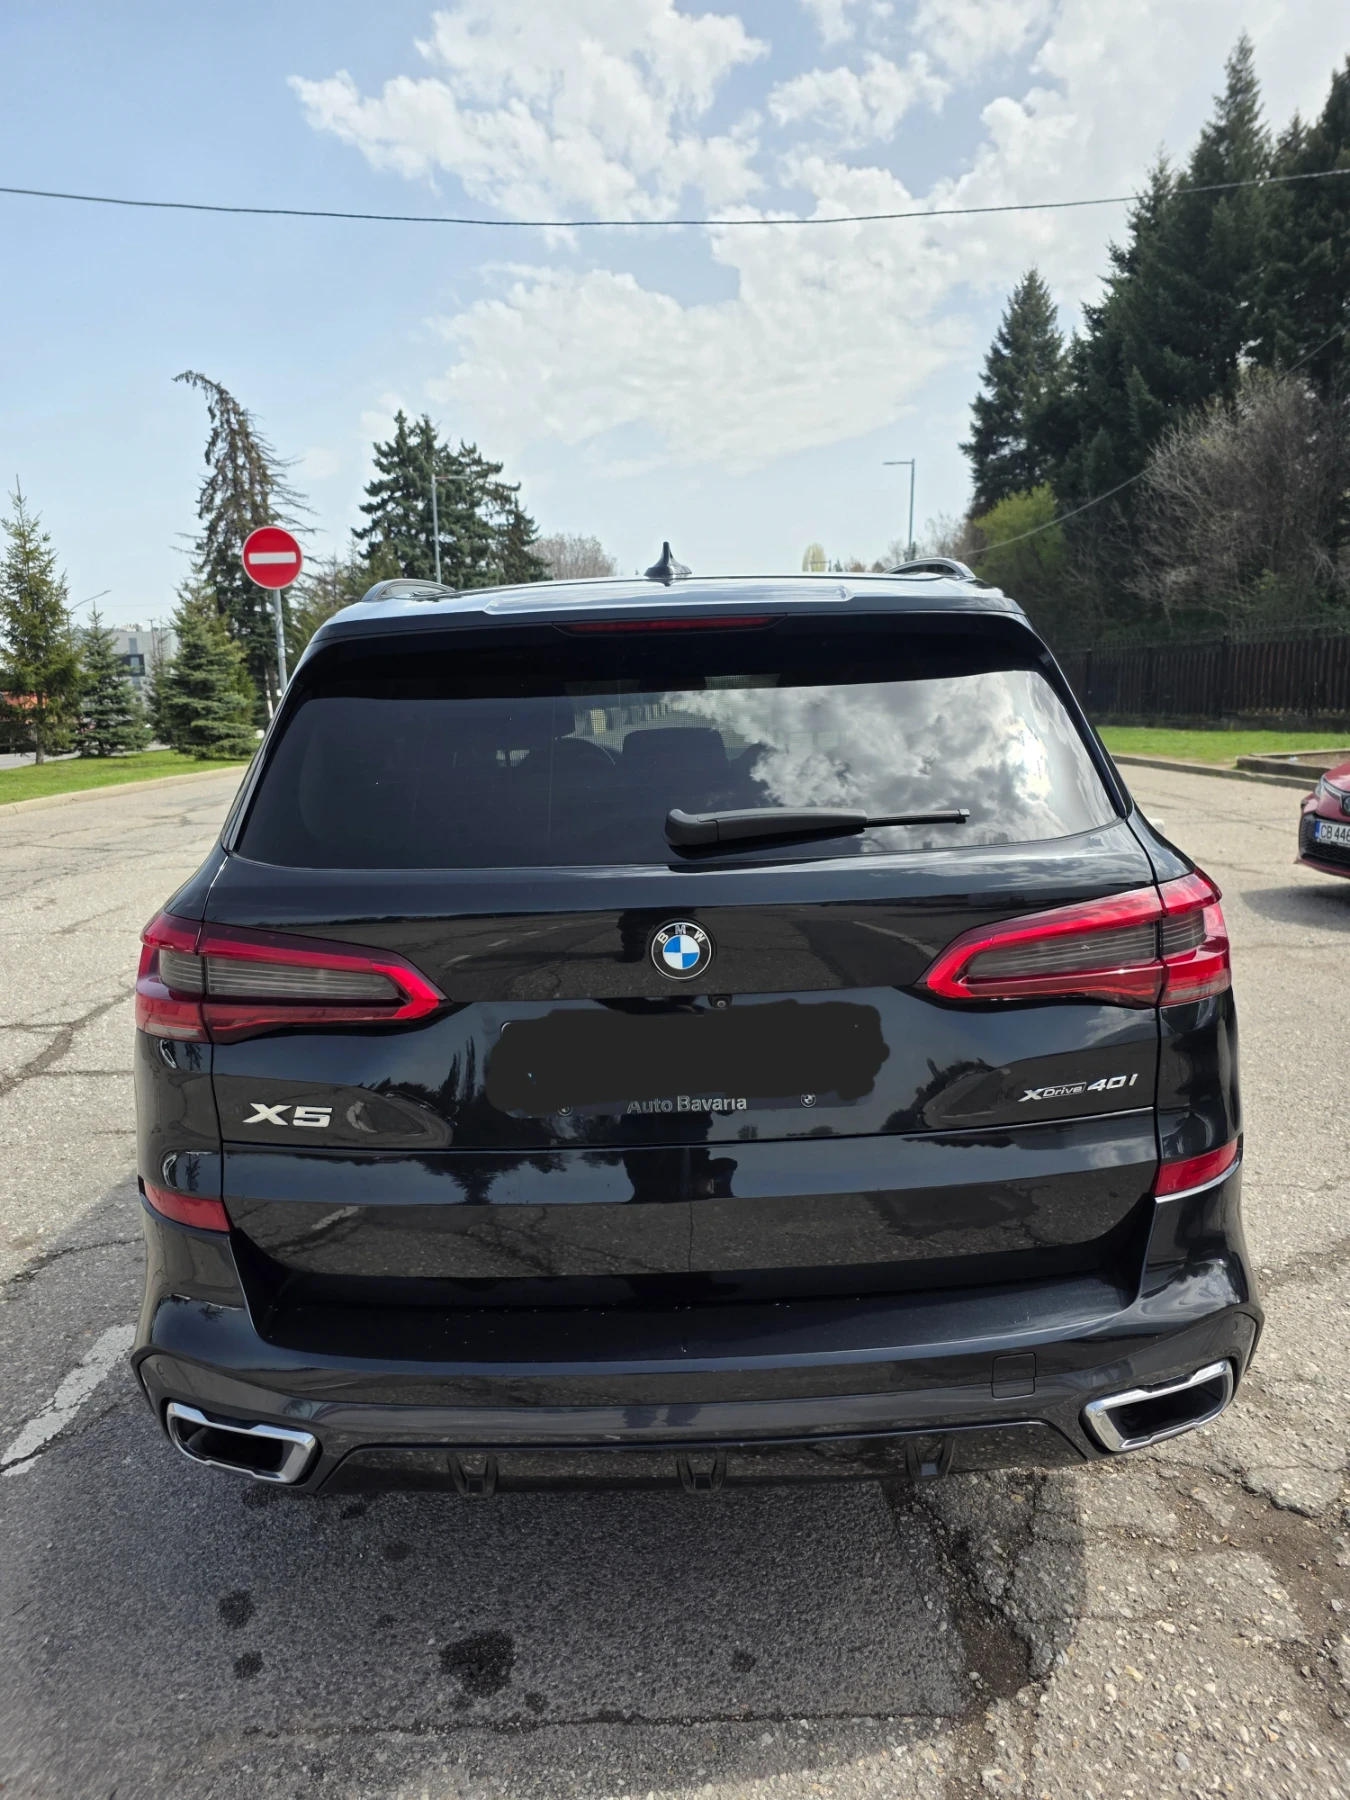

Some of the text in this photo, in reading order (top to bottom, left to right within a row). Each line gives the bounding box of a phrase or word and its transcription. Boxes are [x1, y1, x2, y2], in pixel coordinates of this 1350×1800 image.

[1320, 824, 1333, 840] CB
[657, 924, 706, 945] BMW
[626, 1095, 748, 1114] Auto Bavaria
[242, 1102, 333, 1128] X5
